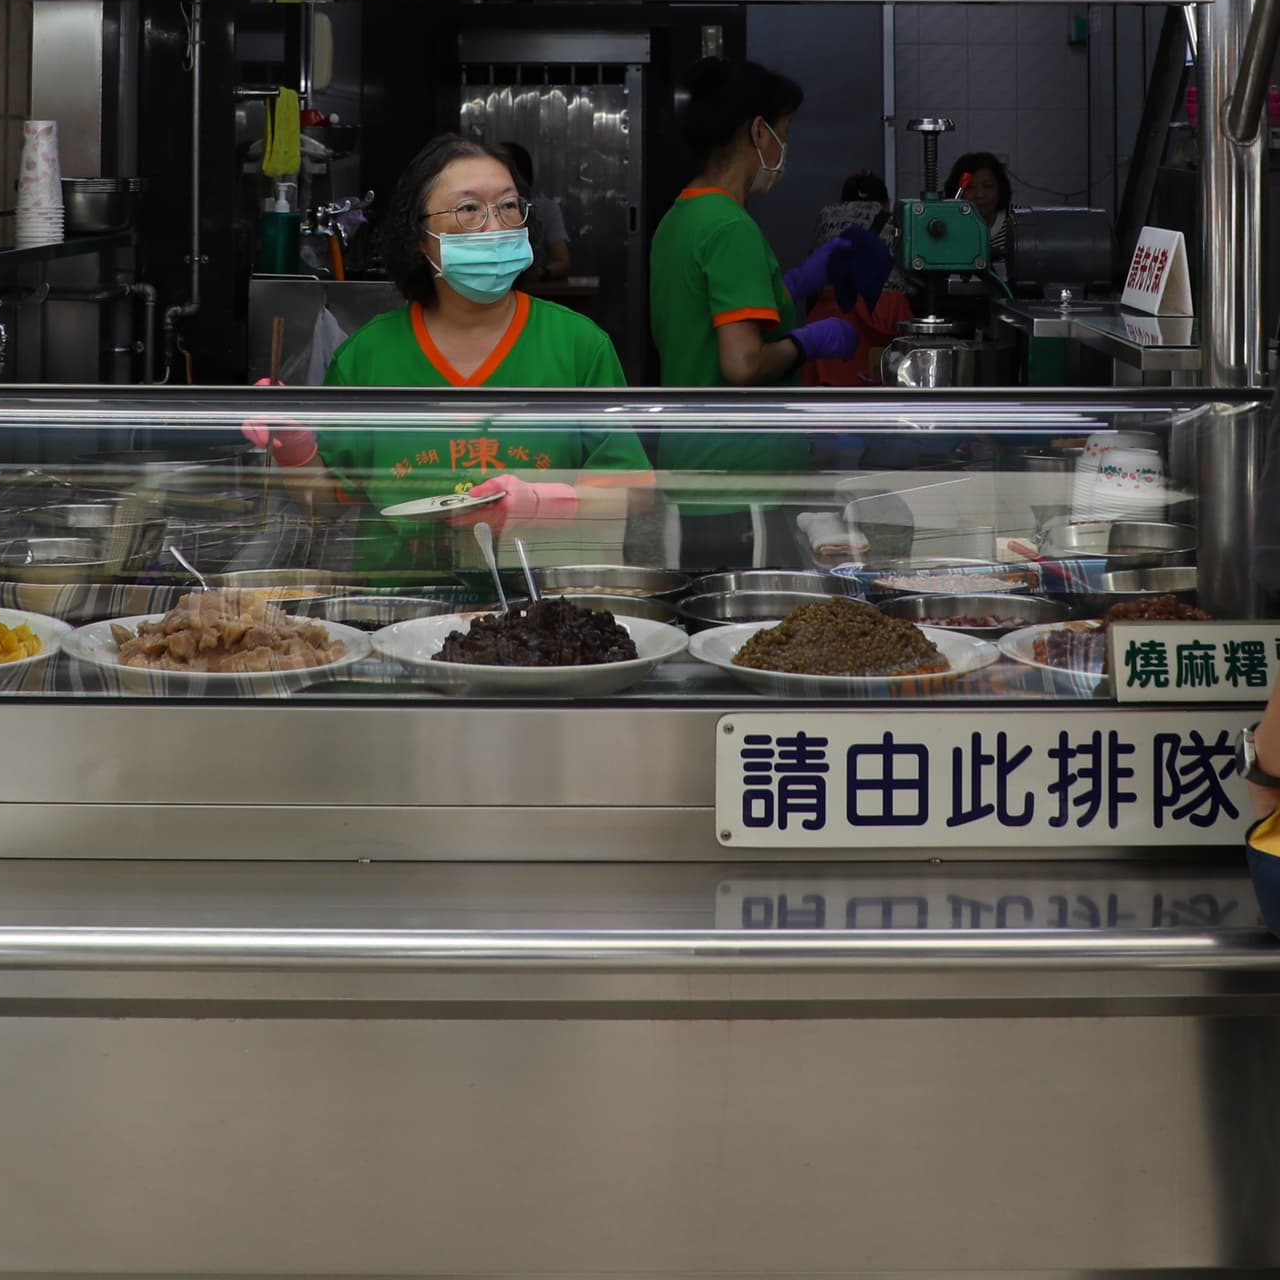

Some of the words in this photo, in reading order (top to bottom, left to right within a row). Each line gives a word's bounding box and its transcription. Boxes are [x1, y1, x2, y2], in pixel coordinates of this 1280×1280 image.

[1125, 639, 1268, 689] 燒麻糬
[740, 731, 1240, 831] 請由此排隊
